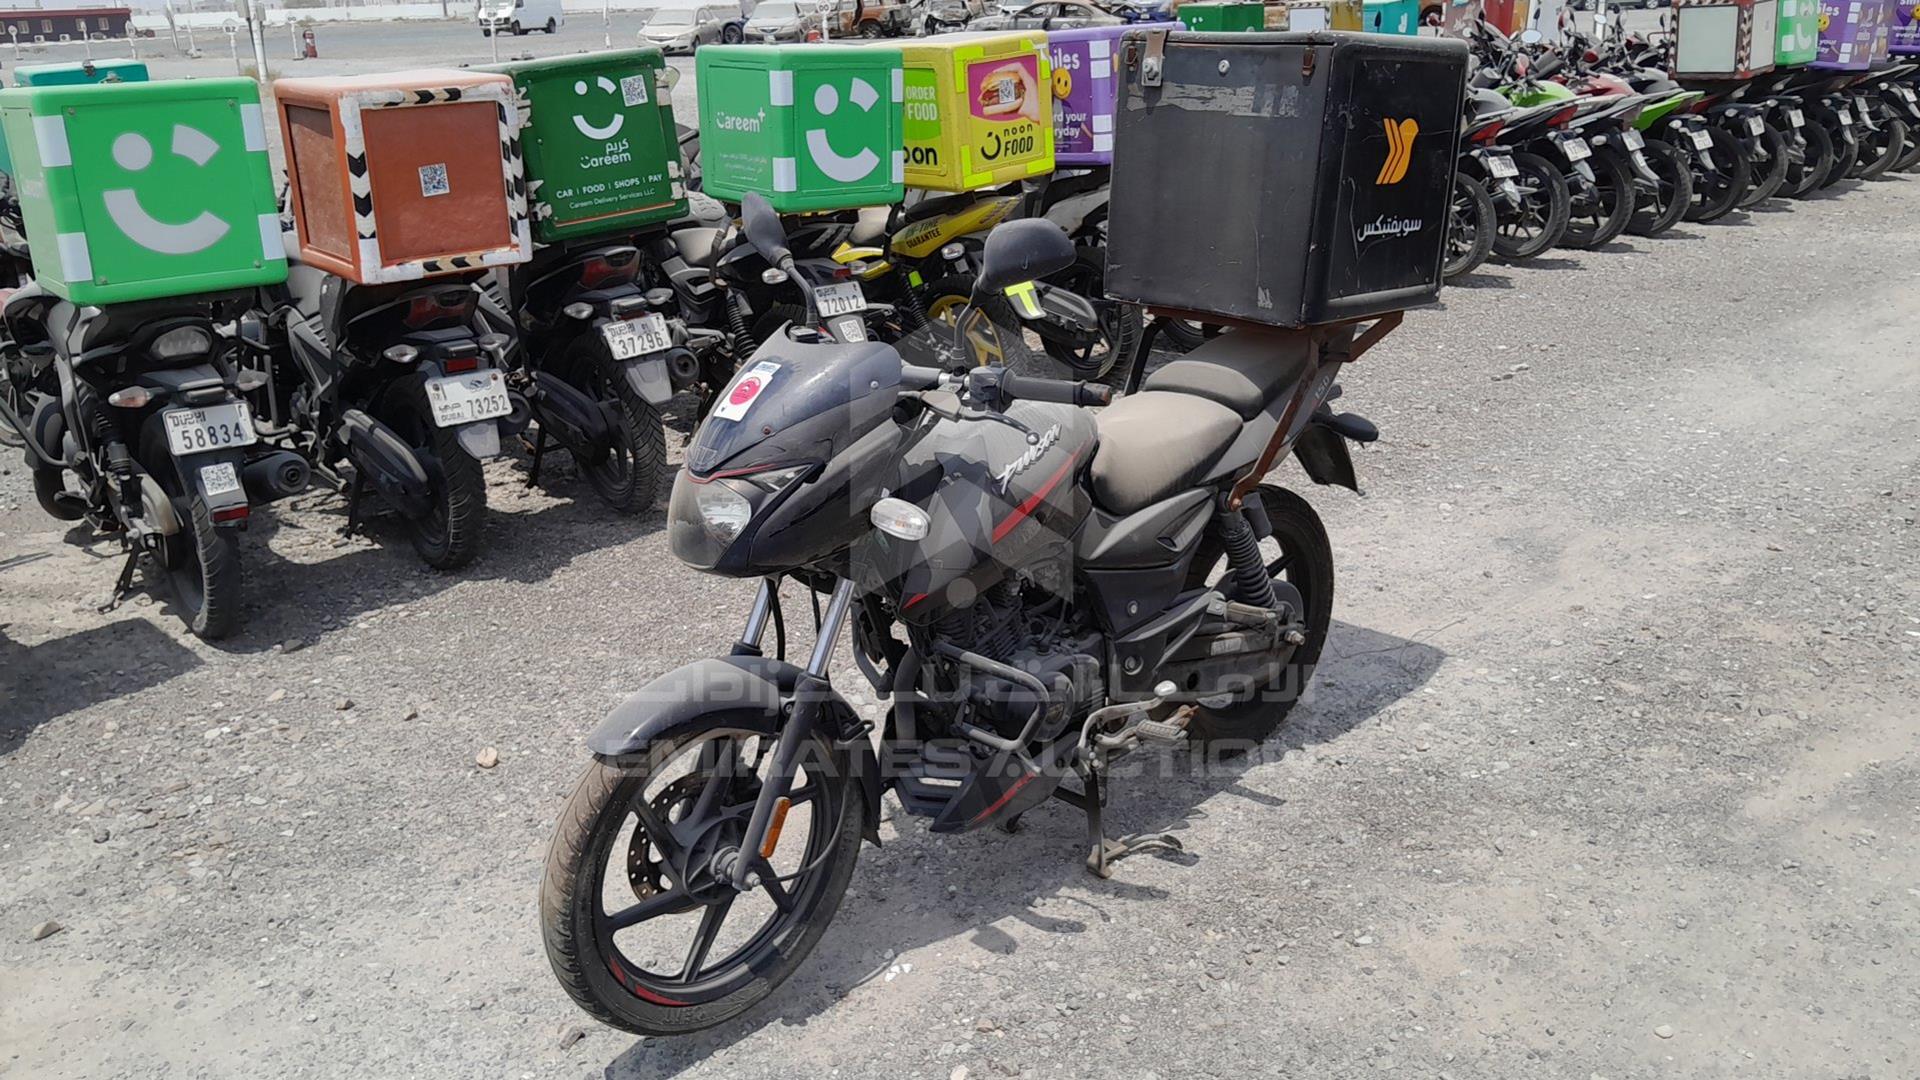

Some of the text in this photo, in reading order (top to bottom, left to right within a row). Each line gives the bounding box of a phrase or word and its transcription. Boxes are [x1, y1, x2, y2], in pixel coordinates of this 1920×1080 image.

[905, 86, 936, 101] ORDER
[907, 103, 938, 121] FOOD
[1065, 113, 1087, 124] your
[1003, 123, 1033, 137] noon
[605, 138, 630, 155] كريم
[1004, 136, 1034, 157] FOOD
[580, 153, 632, 169] Careem
[556, 189, 574, 199] CAR
[582, 183, 606, 194] FOOD
[614, 177, 641, 189] SHOPS
[648, 174, 663, 183] PAY
[823, 294, 862, 315] 72012
[618, 331, 665, 356] 37296
[466, 394, 508, 420] 73252
[181, 421, 244, 450] 58834
